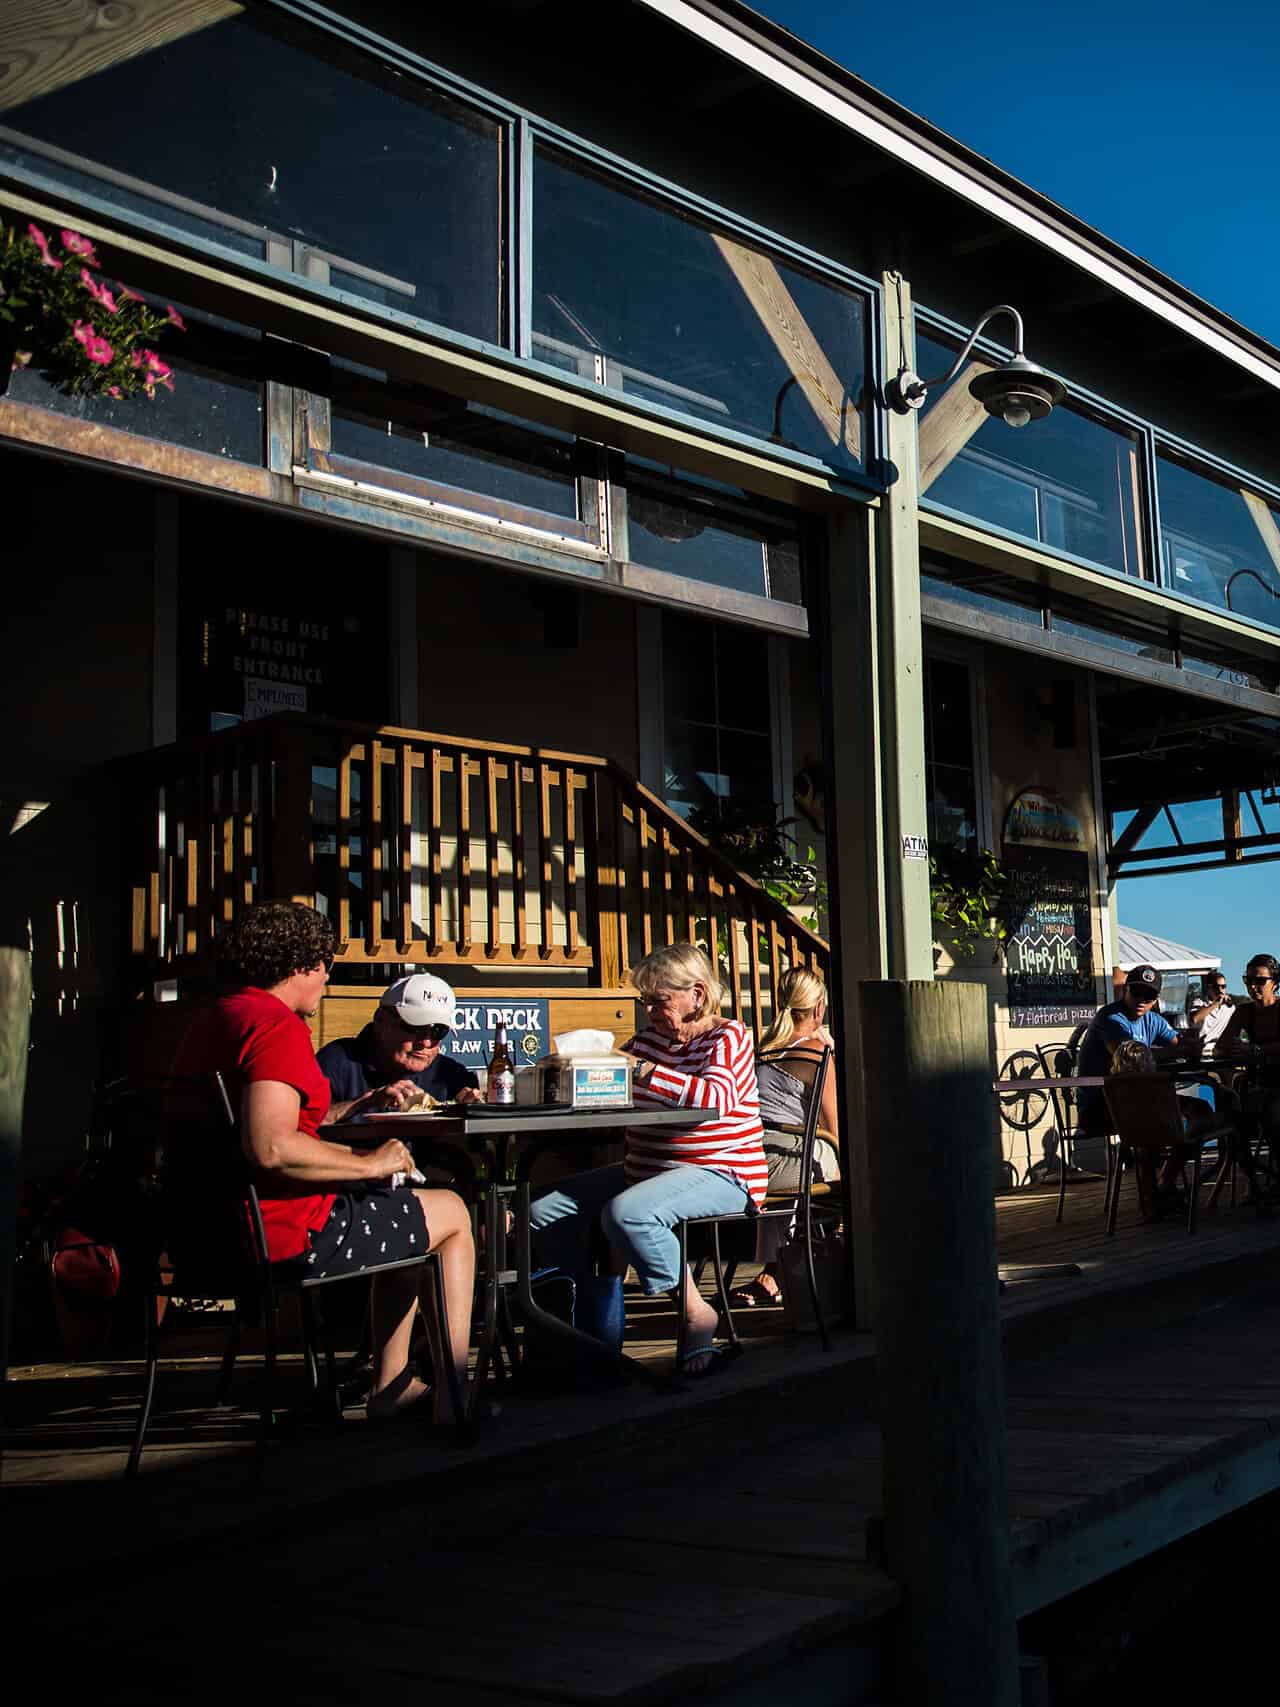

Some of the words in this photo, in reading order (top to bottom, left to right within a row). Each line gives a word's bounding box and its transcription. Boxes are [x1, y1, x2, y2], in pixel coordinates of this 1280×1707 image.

[297, 619, 328, 640] USE
[904, 837, 928, 851] ATM
[1057, 943, 1078, 971] Hou
[451, 1007, 481, 1030] CK
[486, 1007, 542, 1031] DECK
[452, 1039, 482, 1053] RAW
